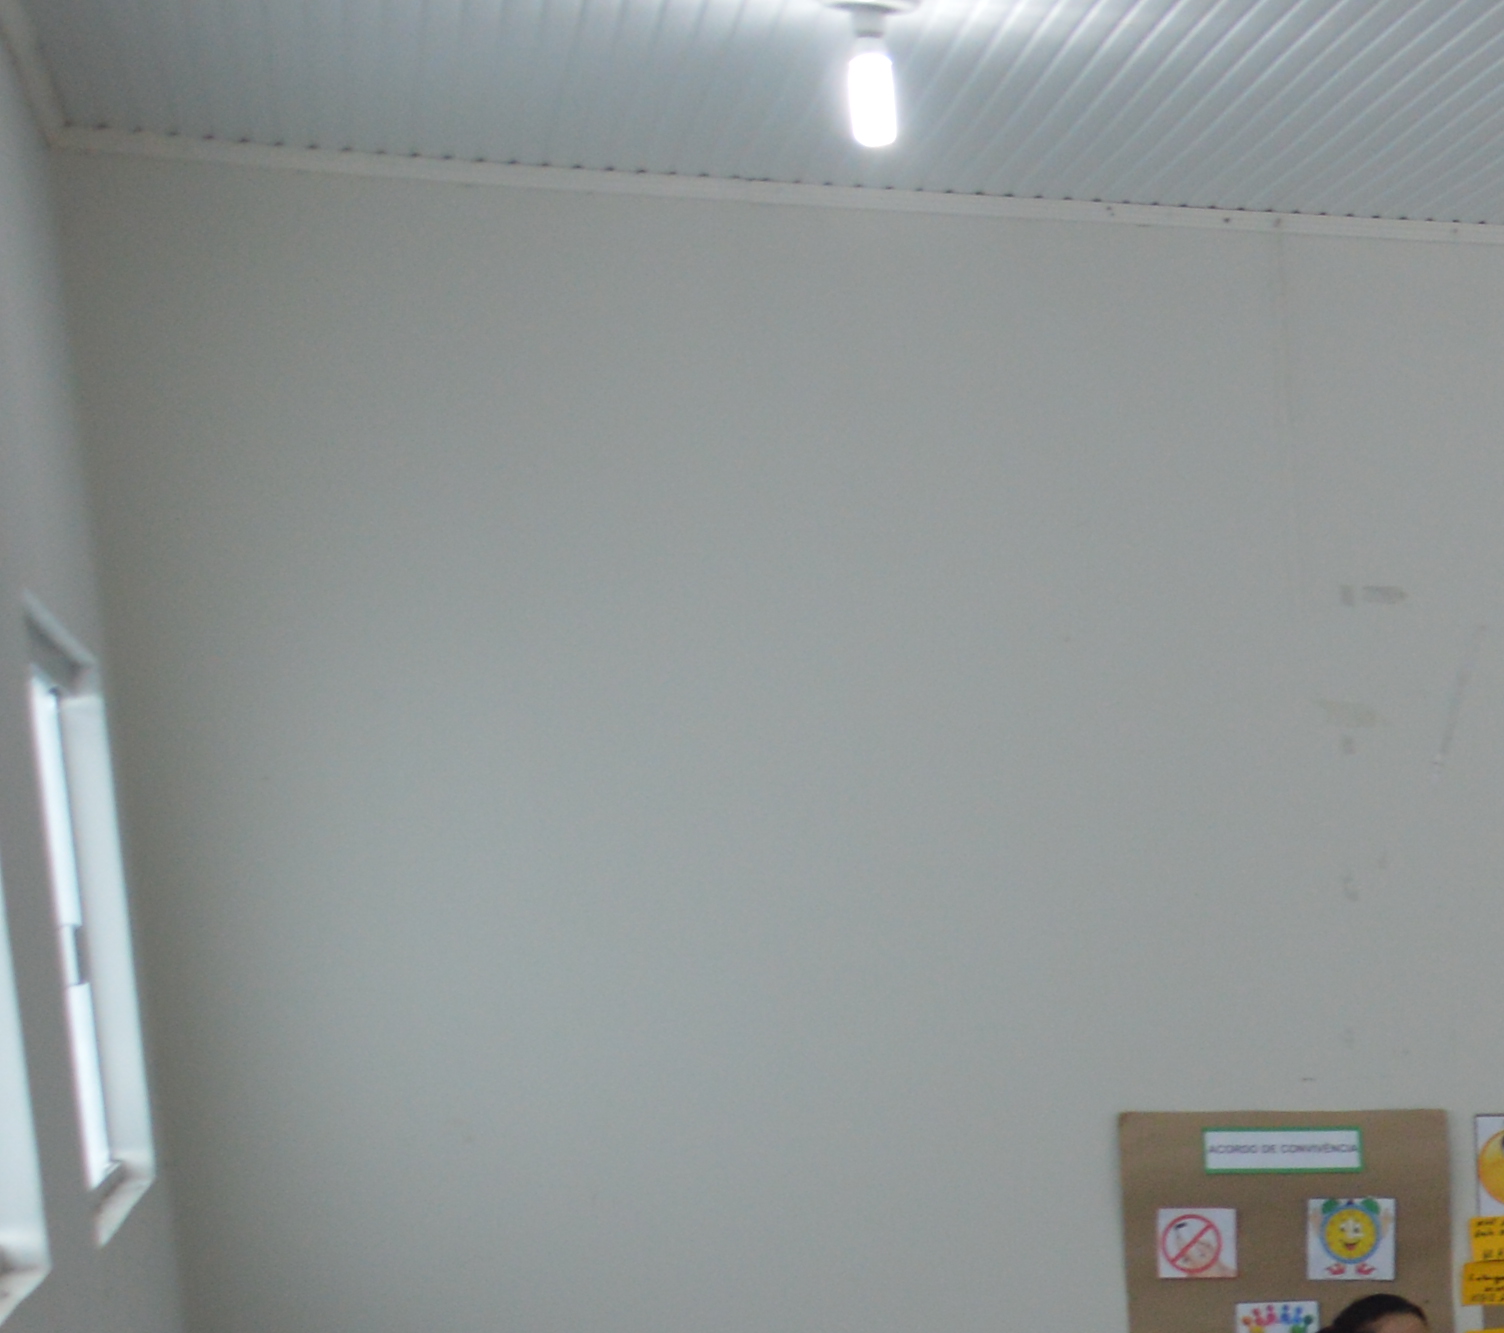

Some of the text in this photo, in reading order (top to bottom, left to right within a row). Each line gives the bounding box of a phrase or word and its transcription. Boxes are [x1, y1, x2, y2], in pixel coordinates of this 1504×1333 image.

[1208, 1142, 1358, 1154] ACORDO DE CONVIVÊNCIA
